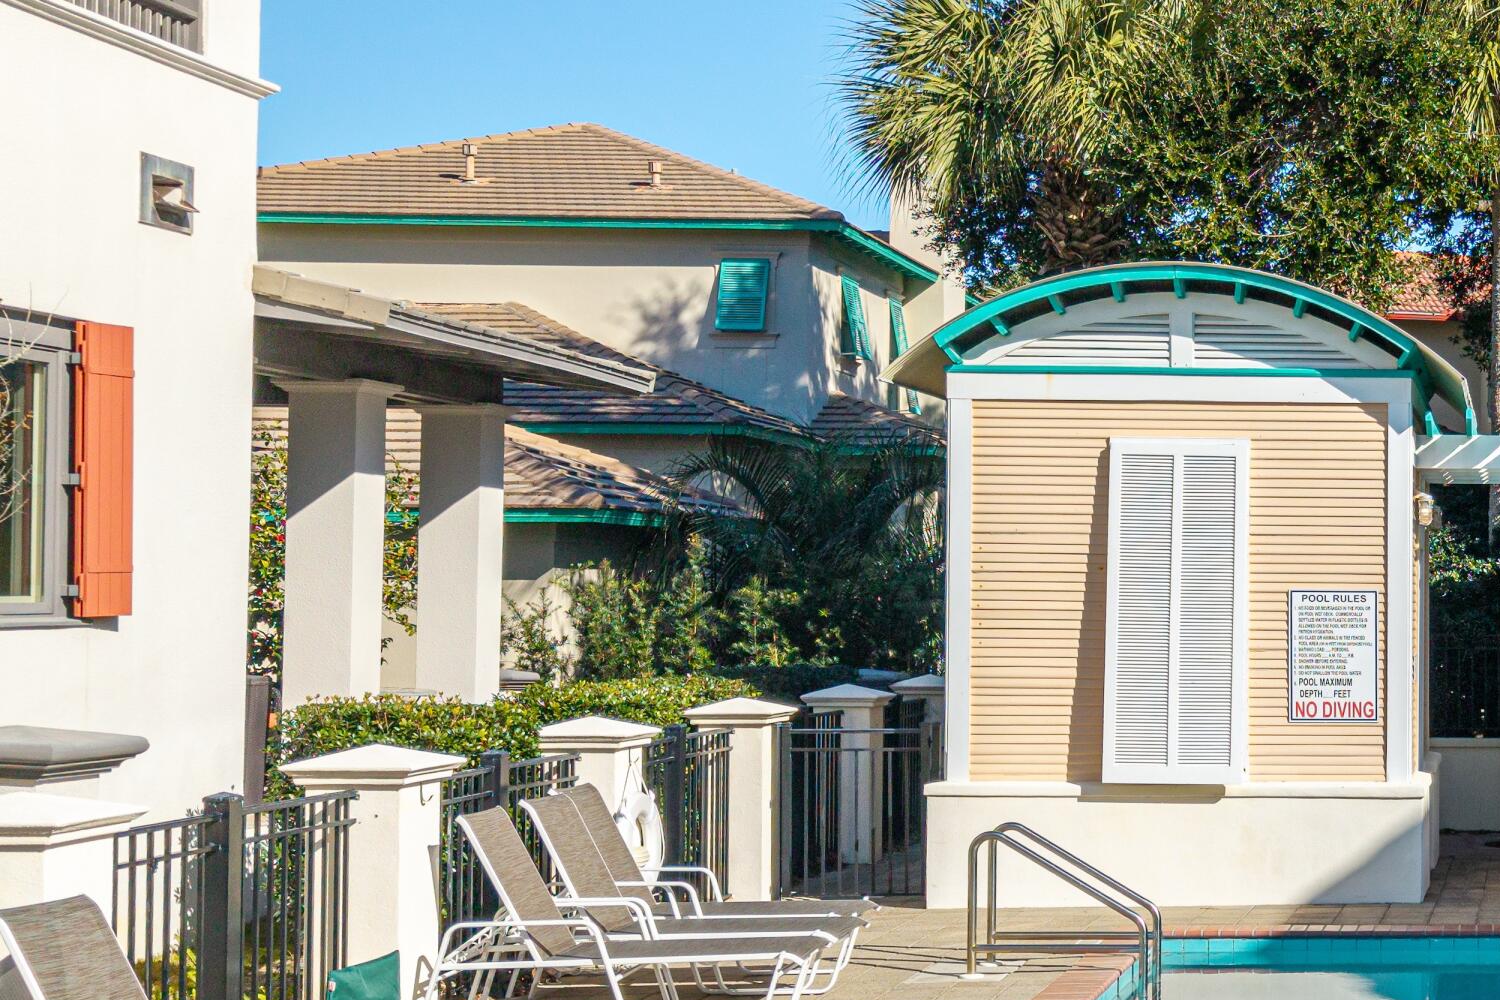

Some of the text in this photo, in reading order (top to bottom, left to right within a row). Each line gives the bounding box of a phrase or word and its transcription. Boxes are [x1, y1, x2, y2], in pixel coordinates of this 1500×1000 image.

[1299, 678, 1318, 686] POOL
[1320, 678, 1352, 686] MAXIMUM
[1300, 690, 1351, 698] DEPTH FEET
[1296, 701, 1374, 718] NO DIVING
